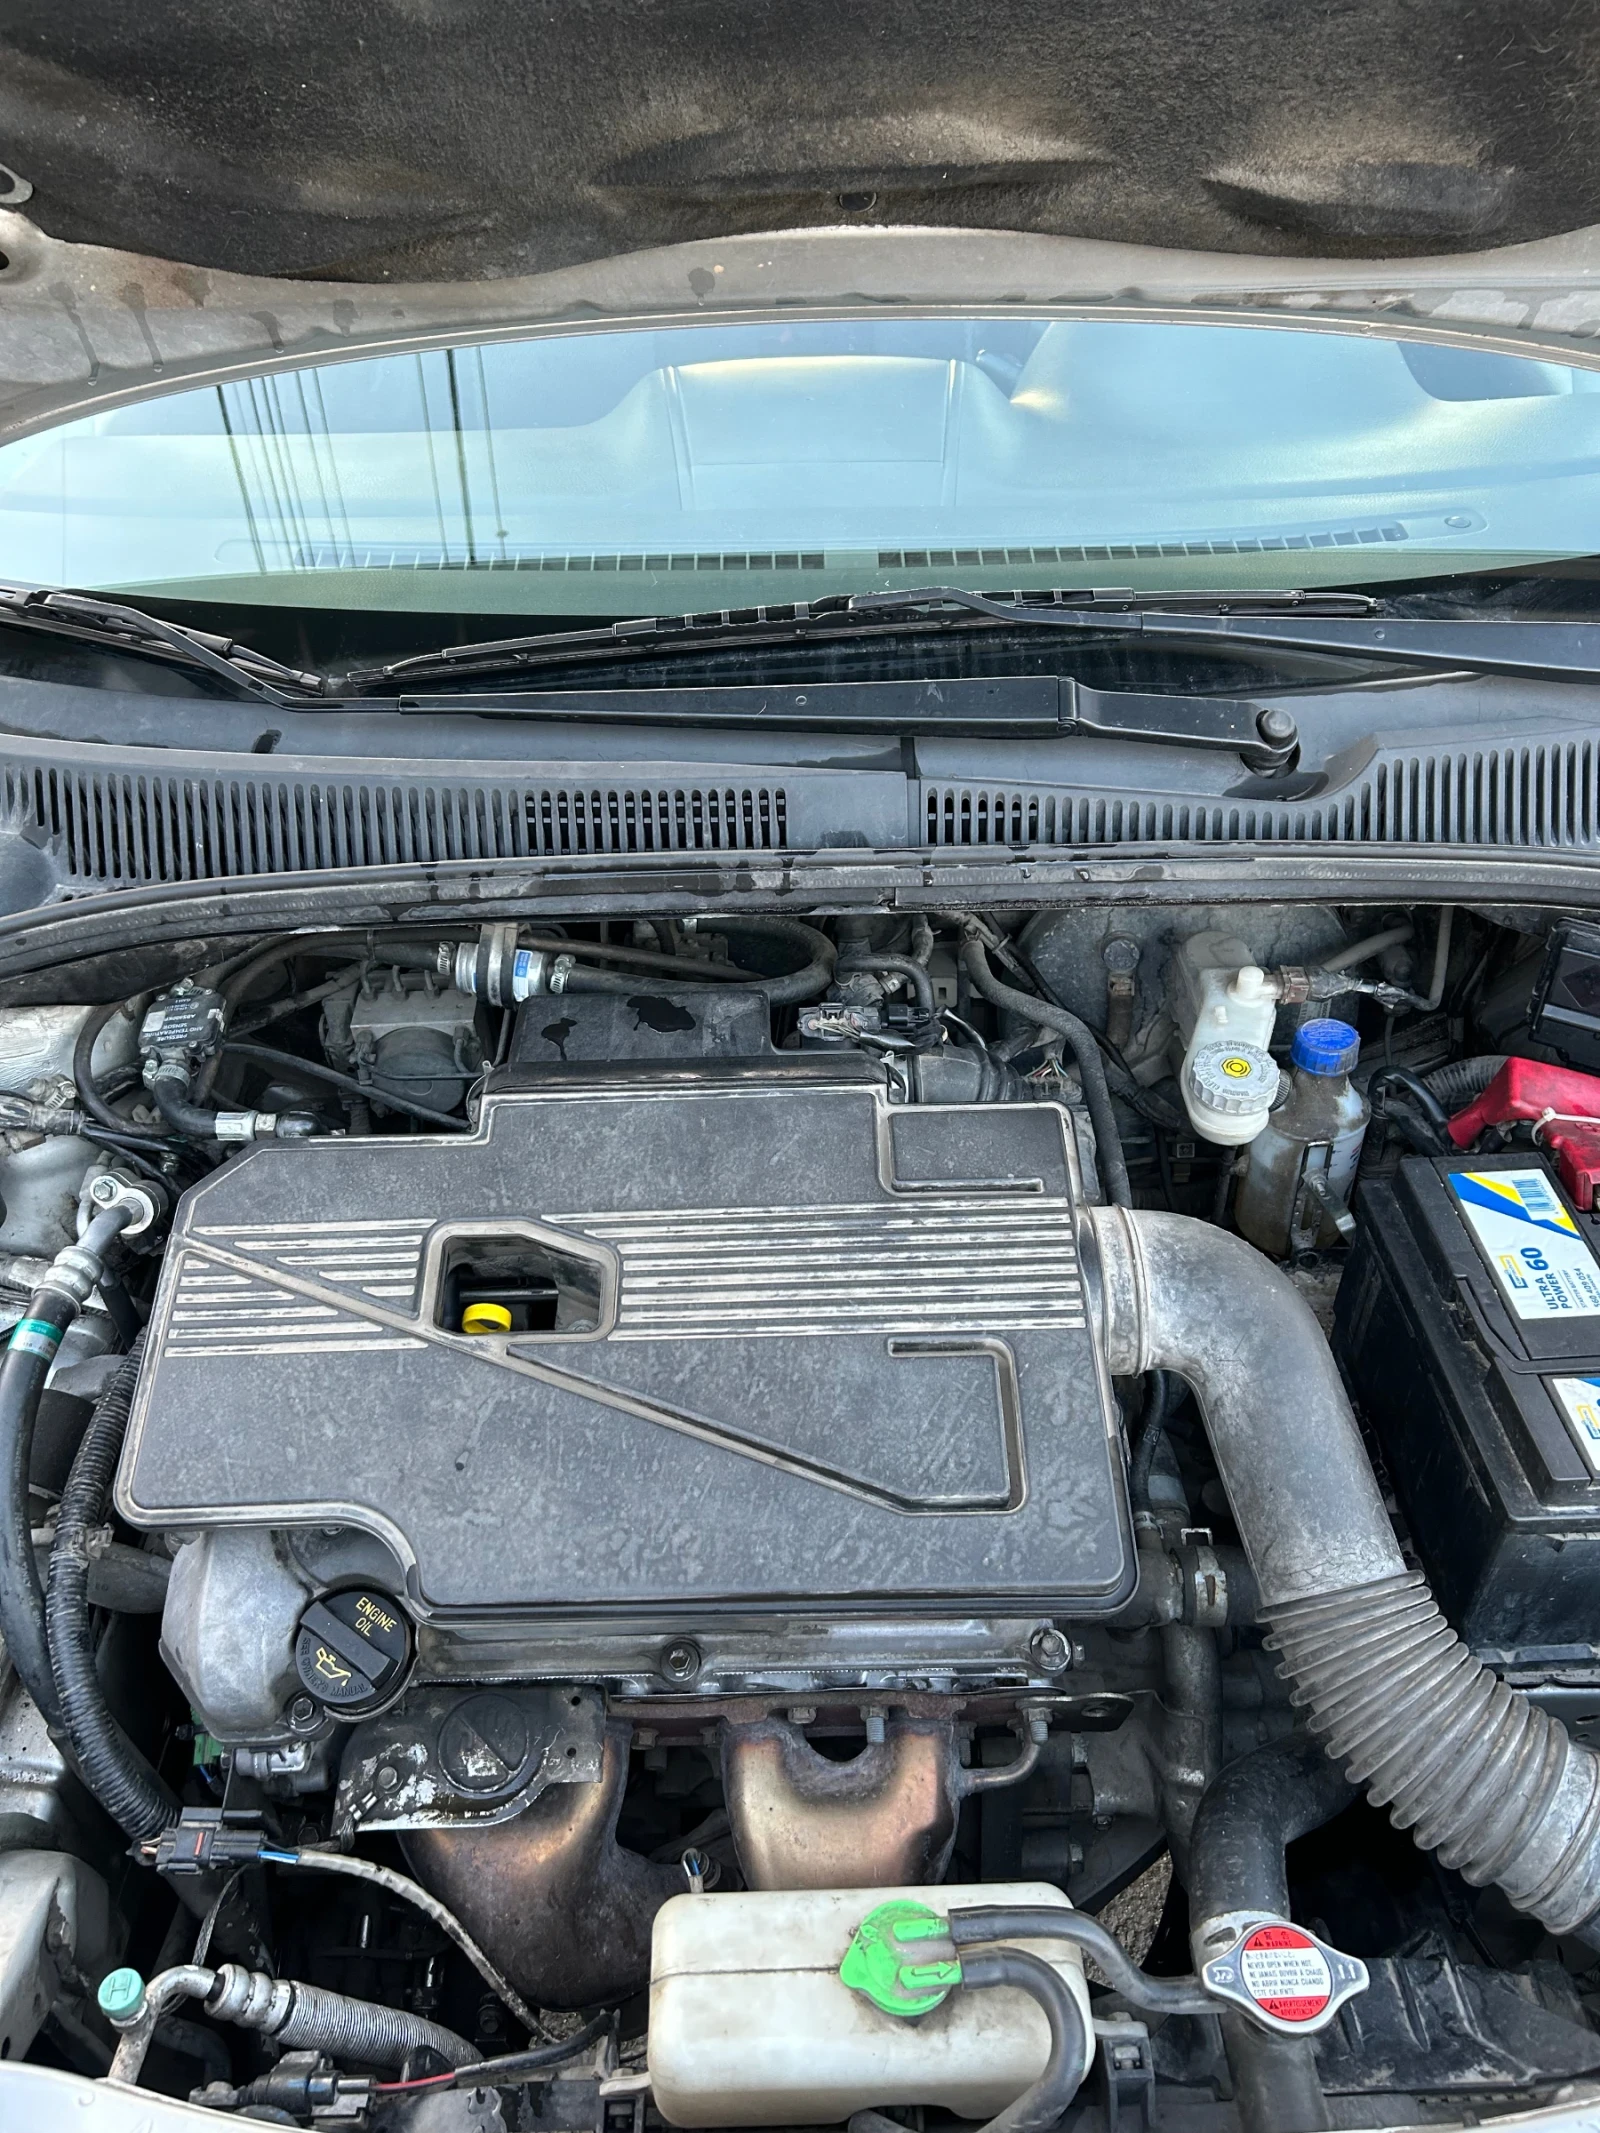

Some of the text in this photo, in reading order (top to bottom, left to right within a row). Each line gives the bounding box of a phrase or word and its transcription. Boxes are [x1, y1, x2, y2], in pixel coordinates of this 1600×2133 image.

[1520, 1247, 1549, 1271] 60
[1534, 1277, 1560, 1310] ULTRA
[1545, 1272, 1573, 1309] POWER
[355, 1596, 398, 1632] ENGINE
[355, 1617, 374, 1637] OIL
[301, 1637, 312, 1656] SEE
[330, 1683, 368, 1698] MANUAL
[1247, 1961, 1265, 1969] NEVER
[1266, 1960, 1282, 1969] OPEN
[1283, 1960, 1299, 1968] WHEN
[1259, 1969, 1277, 1978] JAMAIS
[1278, 1969, 1298, 1977] OUVRIR
[107, 1974, 133, 2003] H
[1251, 1977, 1324, 1988] NO ABRIR NUNCA CUANDO
